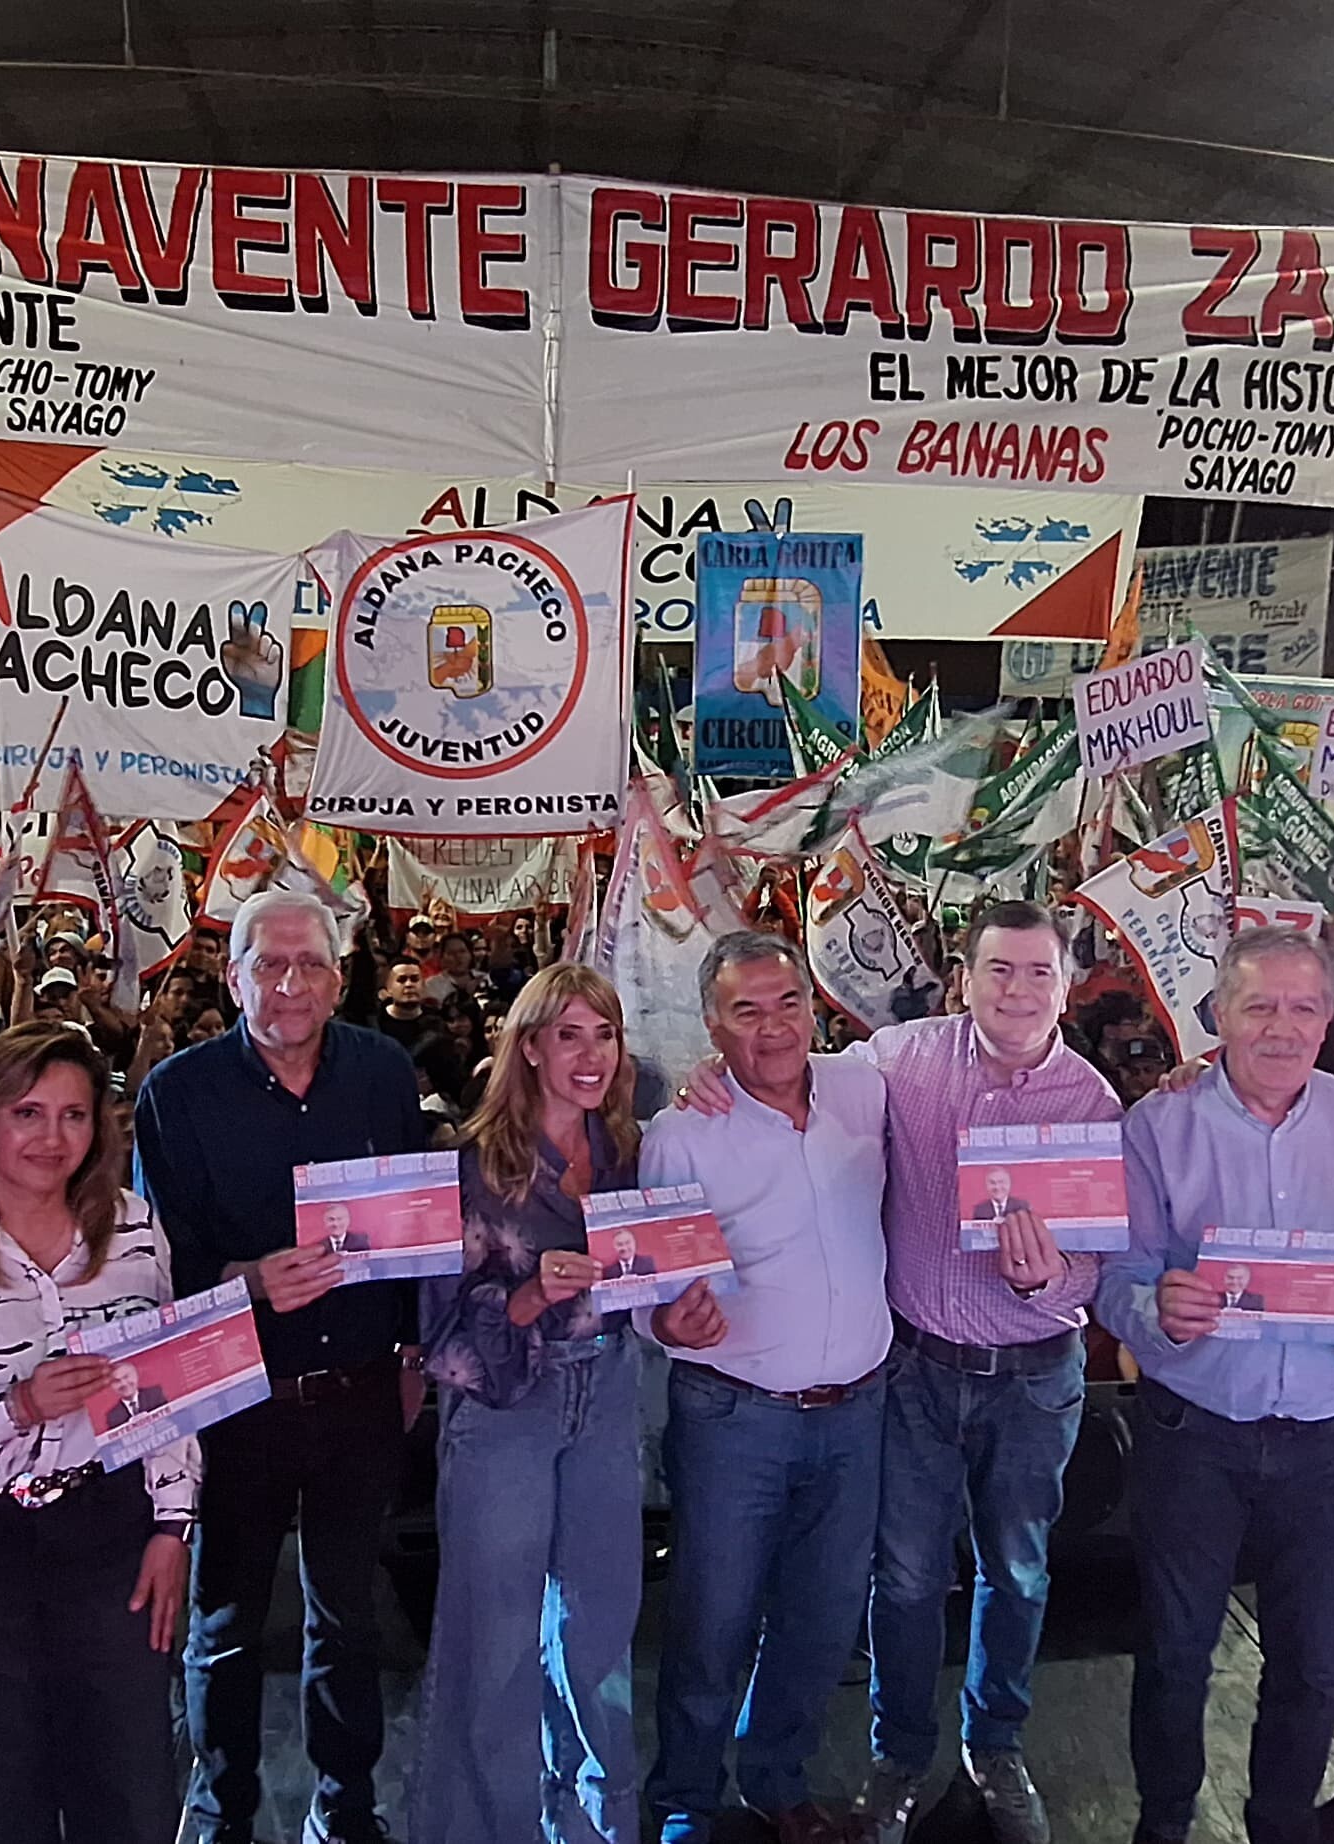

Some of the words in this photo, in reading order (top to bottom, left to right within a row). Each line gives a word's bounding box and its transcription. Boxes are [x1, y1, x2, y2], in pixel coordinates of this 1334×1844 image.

[588, 186, 1133, 346] GERARDO
[869, 352, 925, 402] EL
[946, 354, 1077, 404] MEJOR
[1098, 356, 1156, 406] DE
[1169, 356, 1222, 410] LA
[7, 398, 127, 437] SAYAGO
[785, 418, 881, 473] LOS
[896, 421, 1109, 484] BANANAS
[1184, 454, 1296, 496] SAYAGO
[354, 550, 443, 651] ALDANA
[454, 543, 567, 644] PACHECO
[1086, 649, 1194, 717] EDUARDO
[95, 750, 109, 772] Y
[378, 710, 545, 763] JUVENTUD
[1086, 697, 1205, 768] MAKHOUL
[308, 795, 415, 817] CIRUJA
[426, 798, 446, 817] Y
[456, 793, 620, 817] PERONISTA
